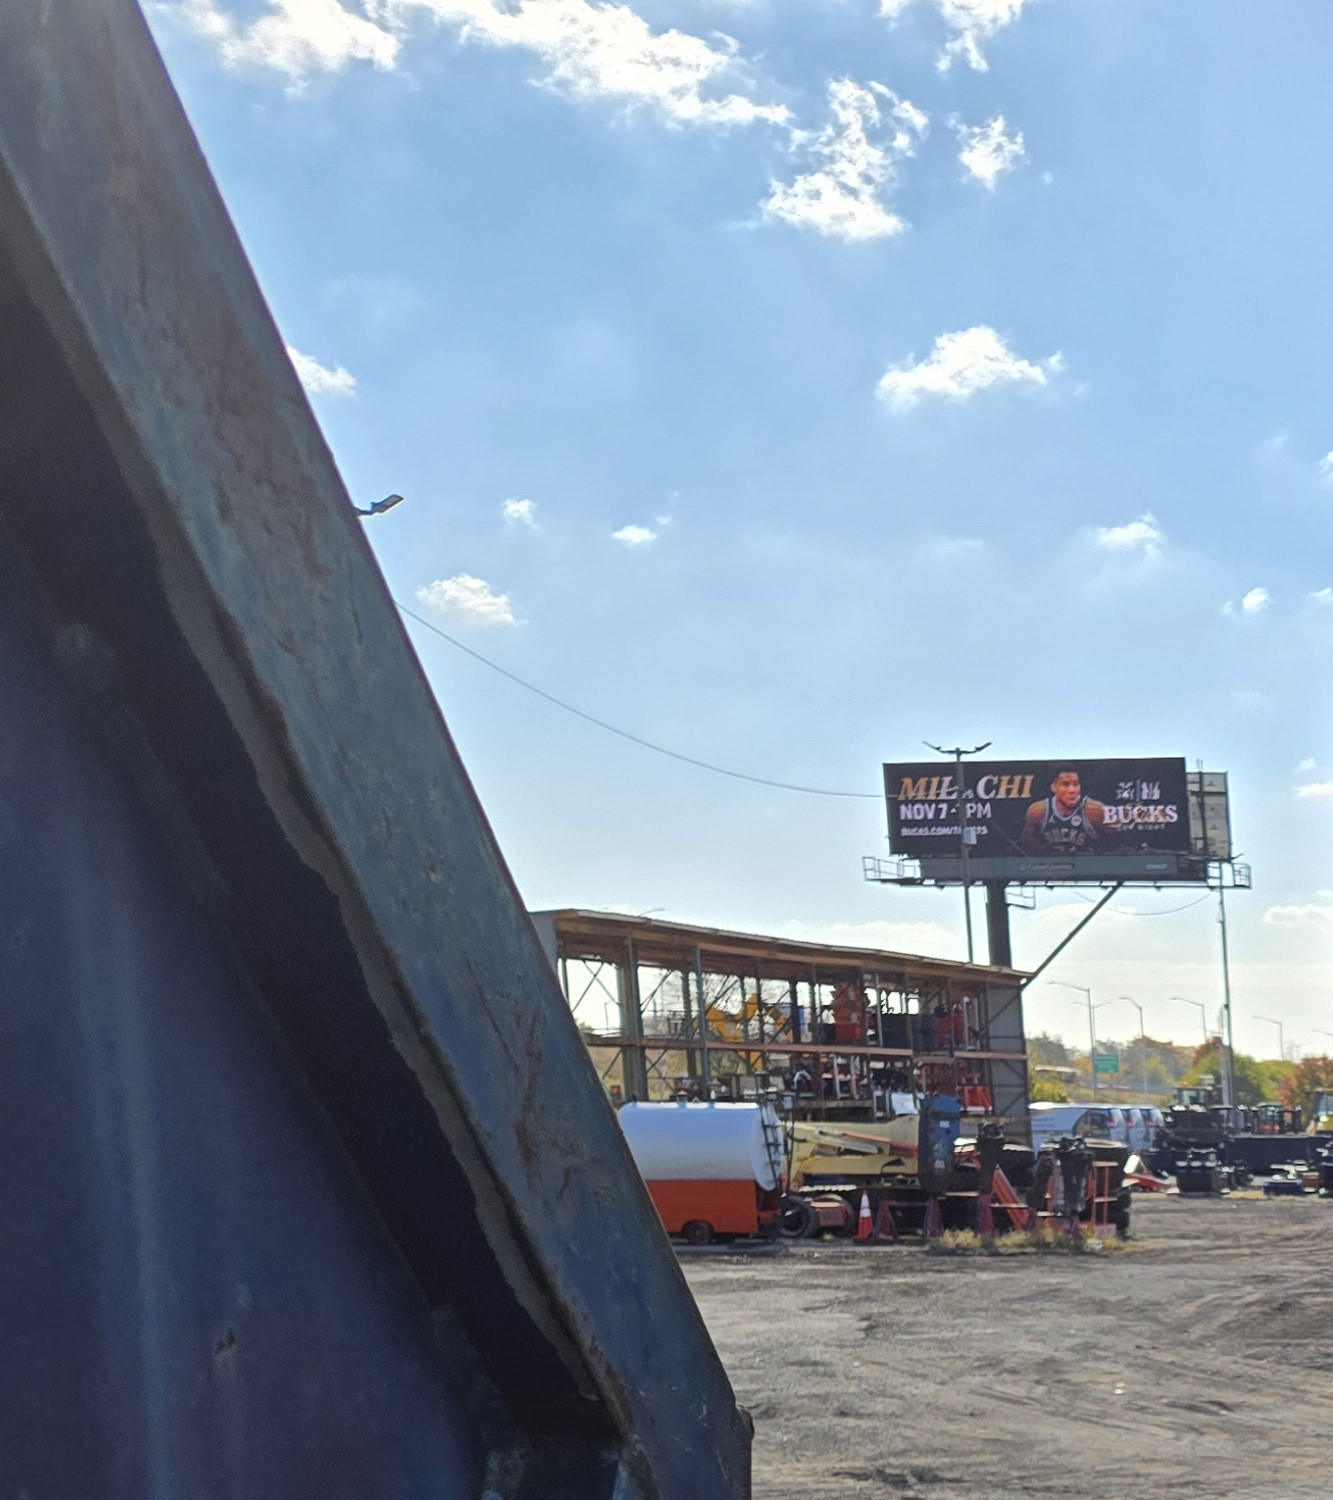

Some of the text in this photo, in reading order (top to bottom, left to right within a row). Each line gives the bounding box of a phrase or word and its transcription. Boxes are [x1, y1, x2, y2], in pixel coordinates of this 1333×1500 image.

[898, 775, 958, 800] MIL
[976, 774, 1034, 799] CHI
[900, 803, 935, 820] NOV
[937, 803, 948, 819] 7
[1102, 804, 1178, 824] BUCKS
